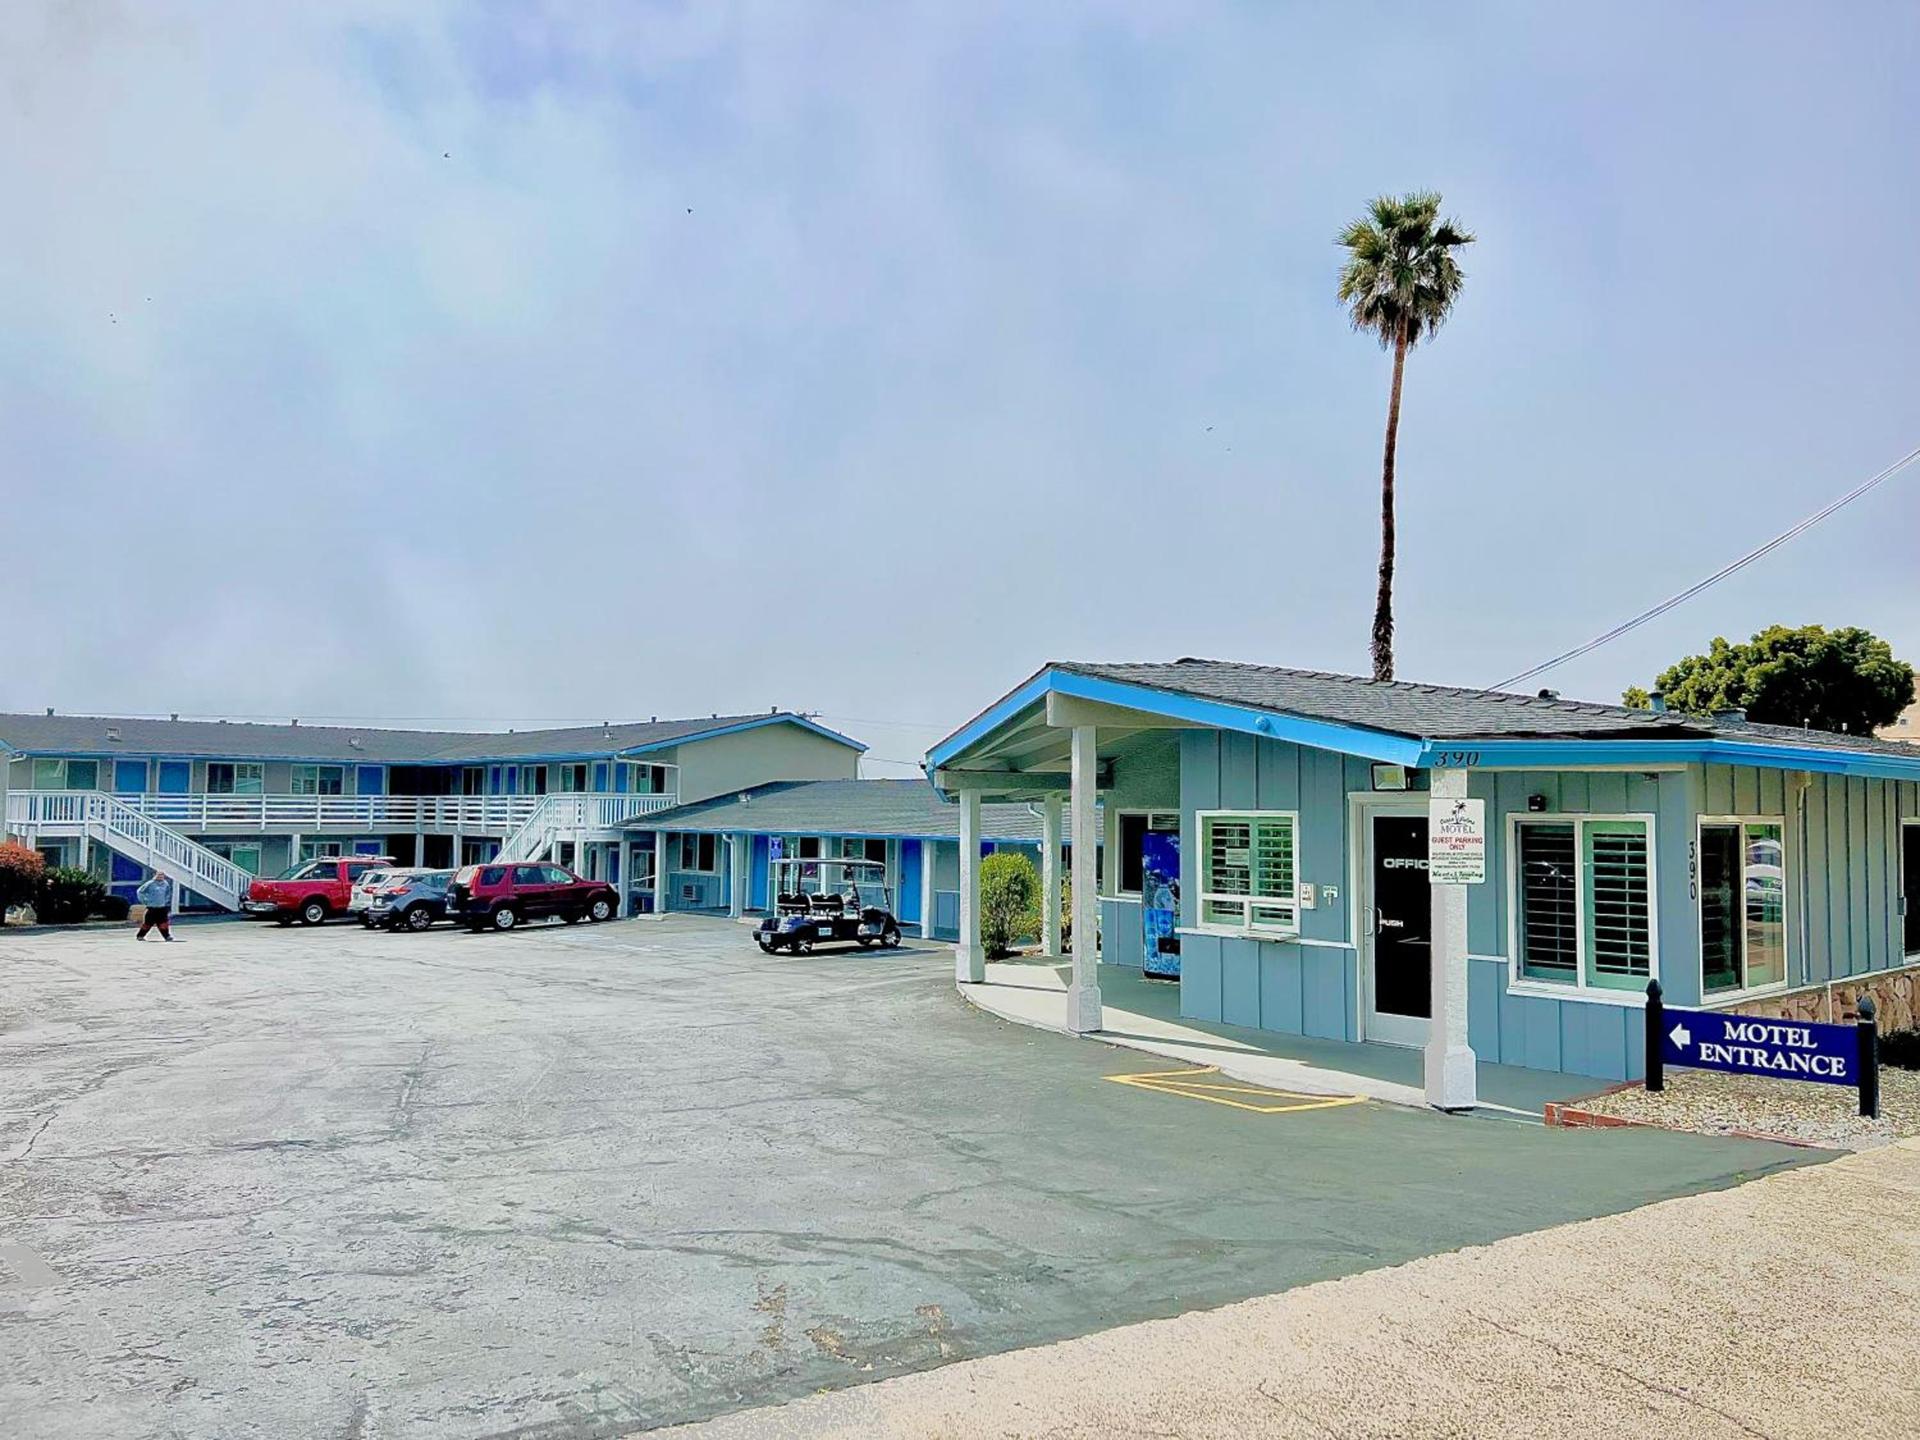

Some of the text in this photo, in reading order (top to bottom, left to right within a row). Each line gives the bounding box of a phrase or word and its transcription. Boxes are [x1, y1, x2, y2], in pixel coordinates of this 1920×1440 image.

[1434, 751, 1479, 767] 390
[1440, 825, 1476, 834] MOTEL
[1431, 836, 1483, 845] GUEST PARKING
[1383, 858, 1430, 869] OFFIC
[1689, 841, 1697, 900] 390
[1723, 1021, 1818, 1049] MOTEL
[1699, 1042, 1846, 1077] ENTRANCE
